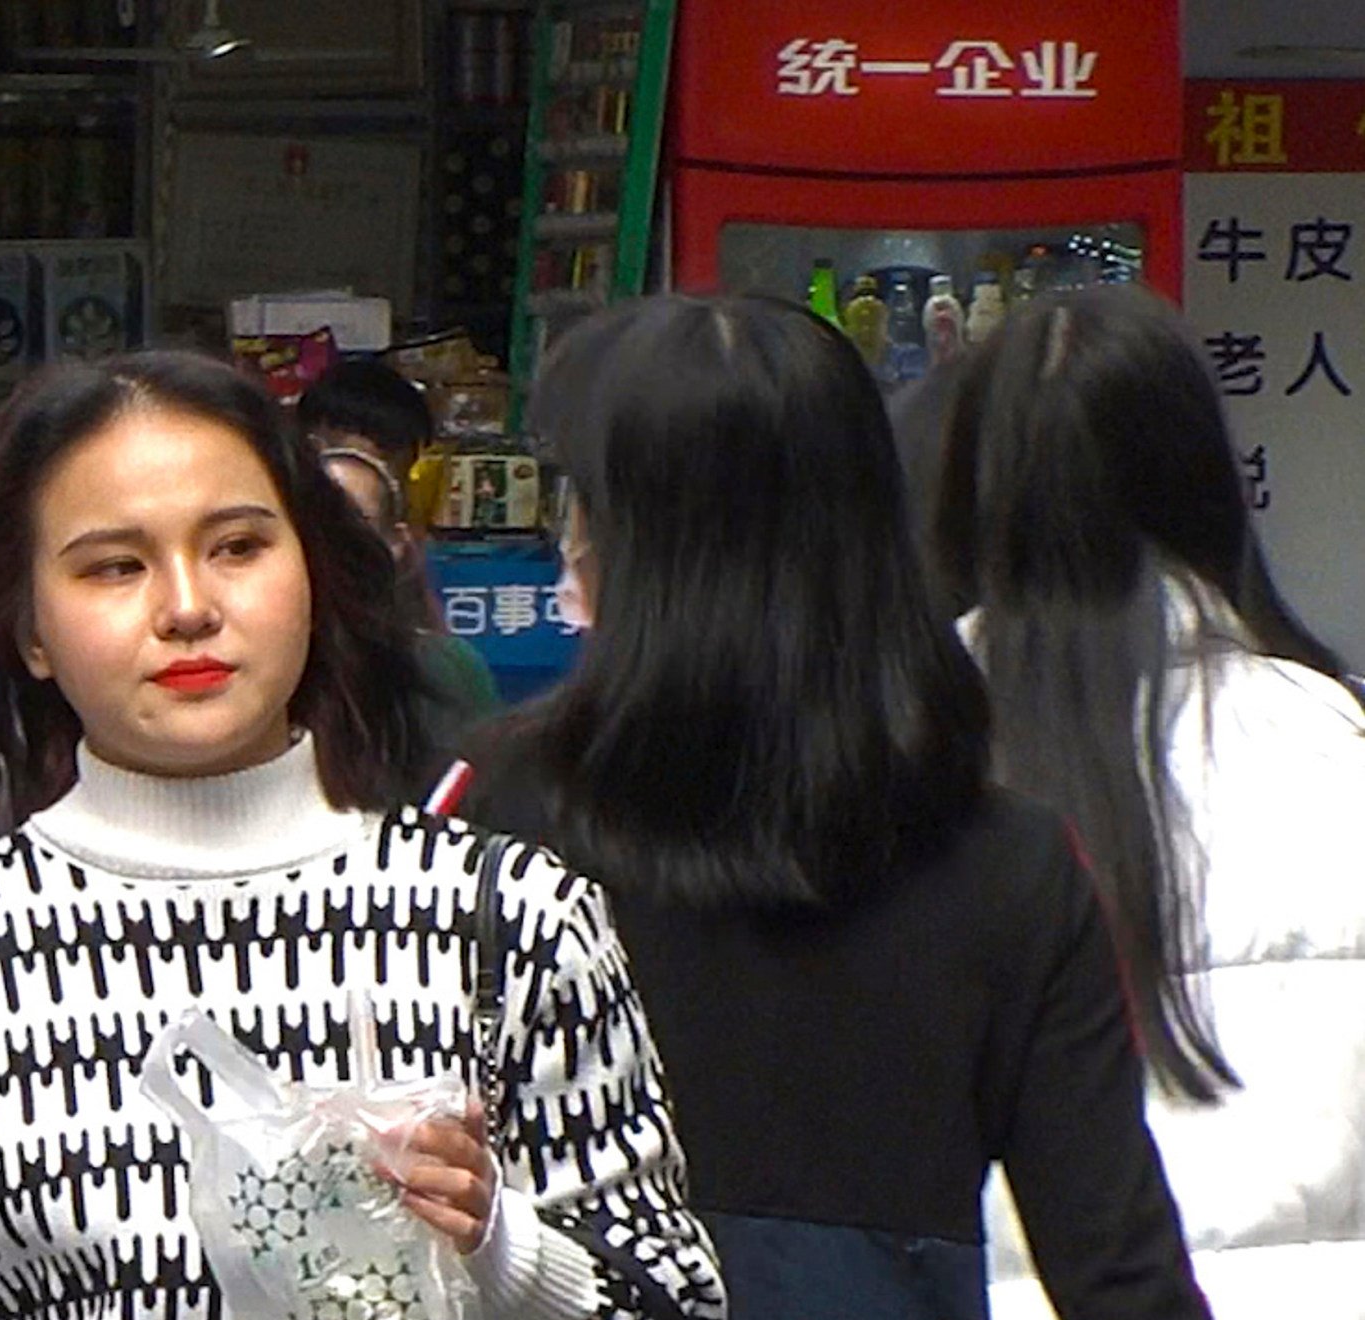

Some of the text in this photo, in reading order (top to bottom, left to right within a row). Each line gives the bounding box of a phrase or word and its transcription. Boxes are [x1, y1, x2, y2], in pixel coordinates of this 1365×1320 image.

[777, 39, 1097, 97] 统一企业
[1206, 88, 1288, 165] 祖
[1198, 217, 1352, 283] 牛皮
[1204, 331, 1351, 396] 老人
